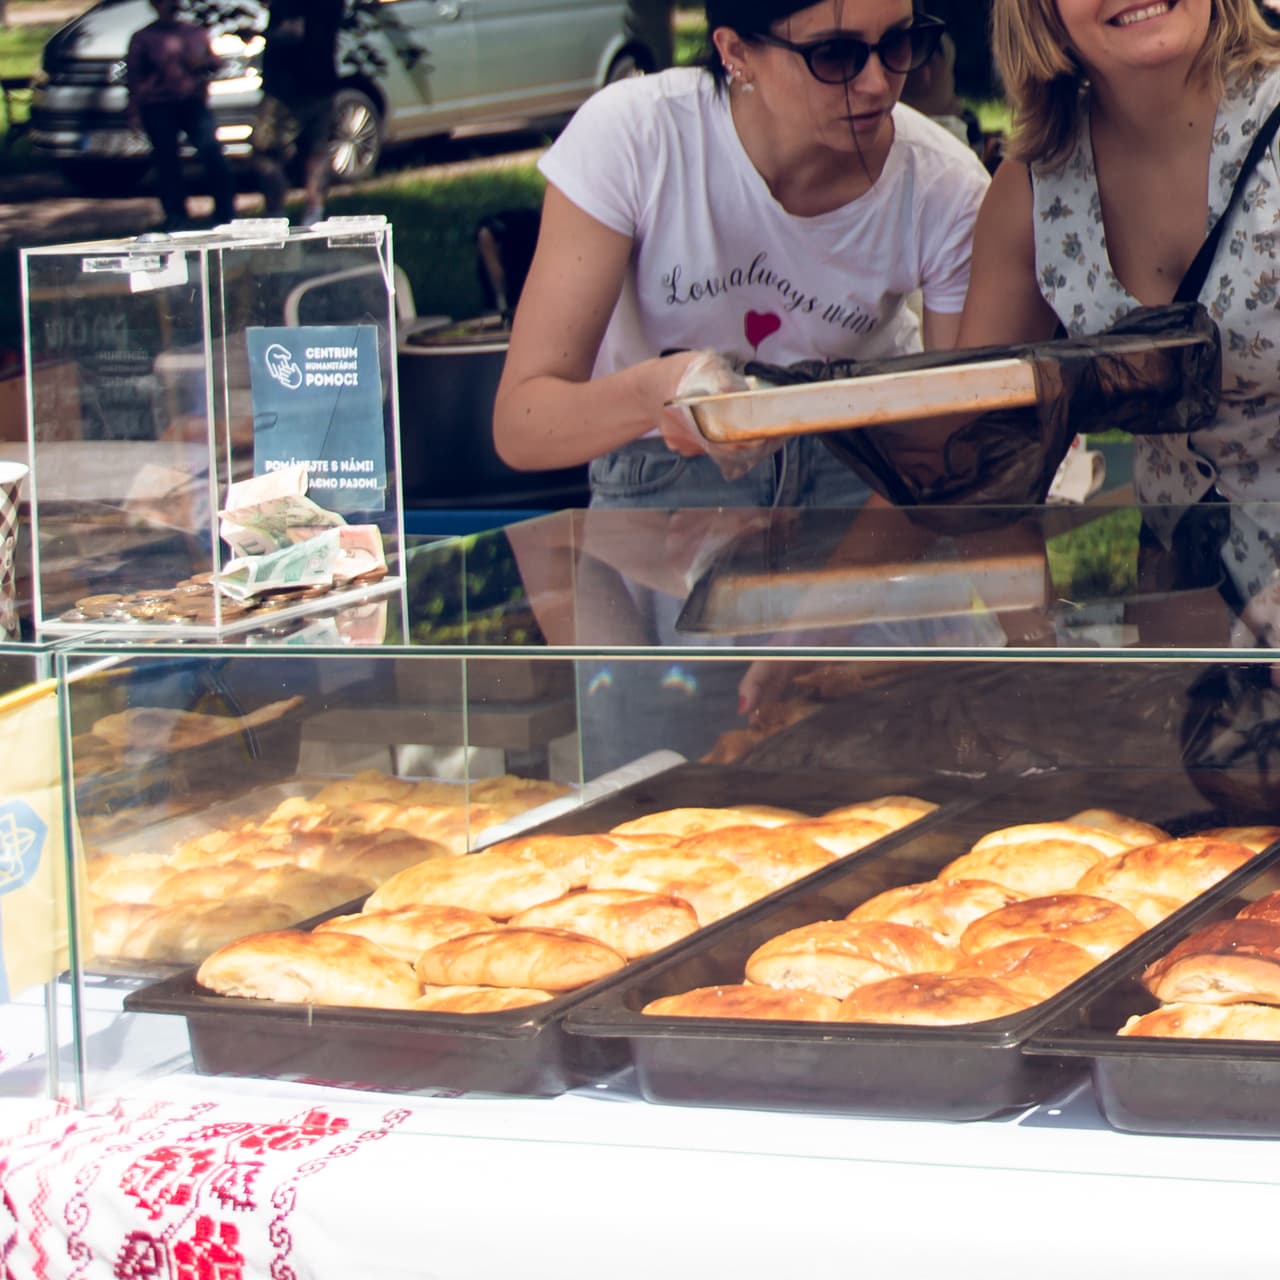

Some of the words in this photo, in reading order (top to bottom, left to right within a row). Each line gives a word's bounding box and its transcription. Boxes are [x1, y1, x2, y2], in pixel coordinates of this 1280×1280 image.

[730, 251, 818, 313] always
[305, 346, 358, 360] CENTRUM
[305, 372, 359, 387] POMOCI
